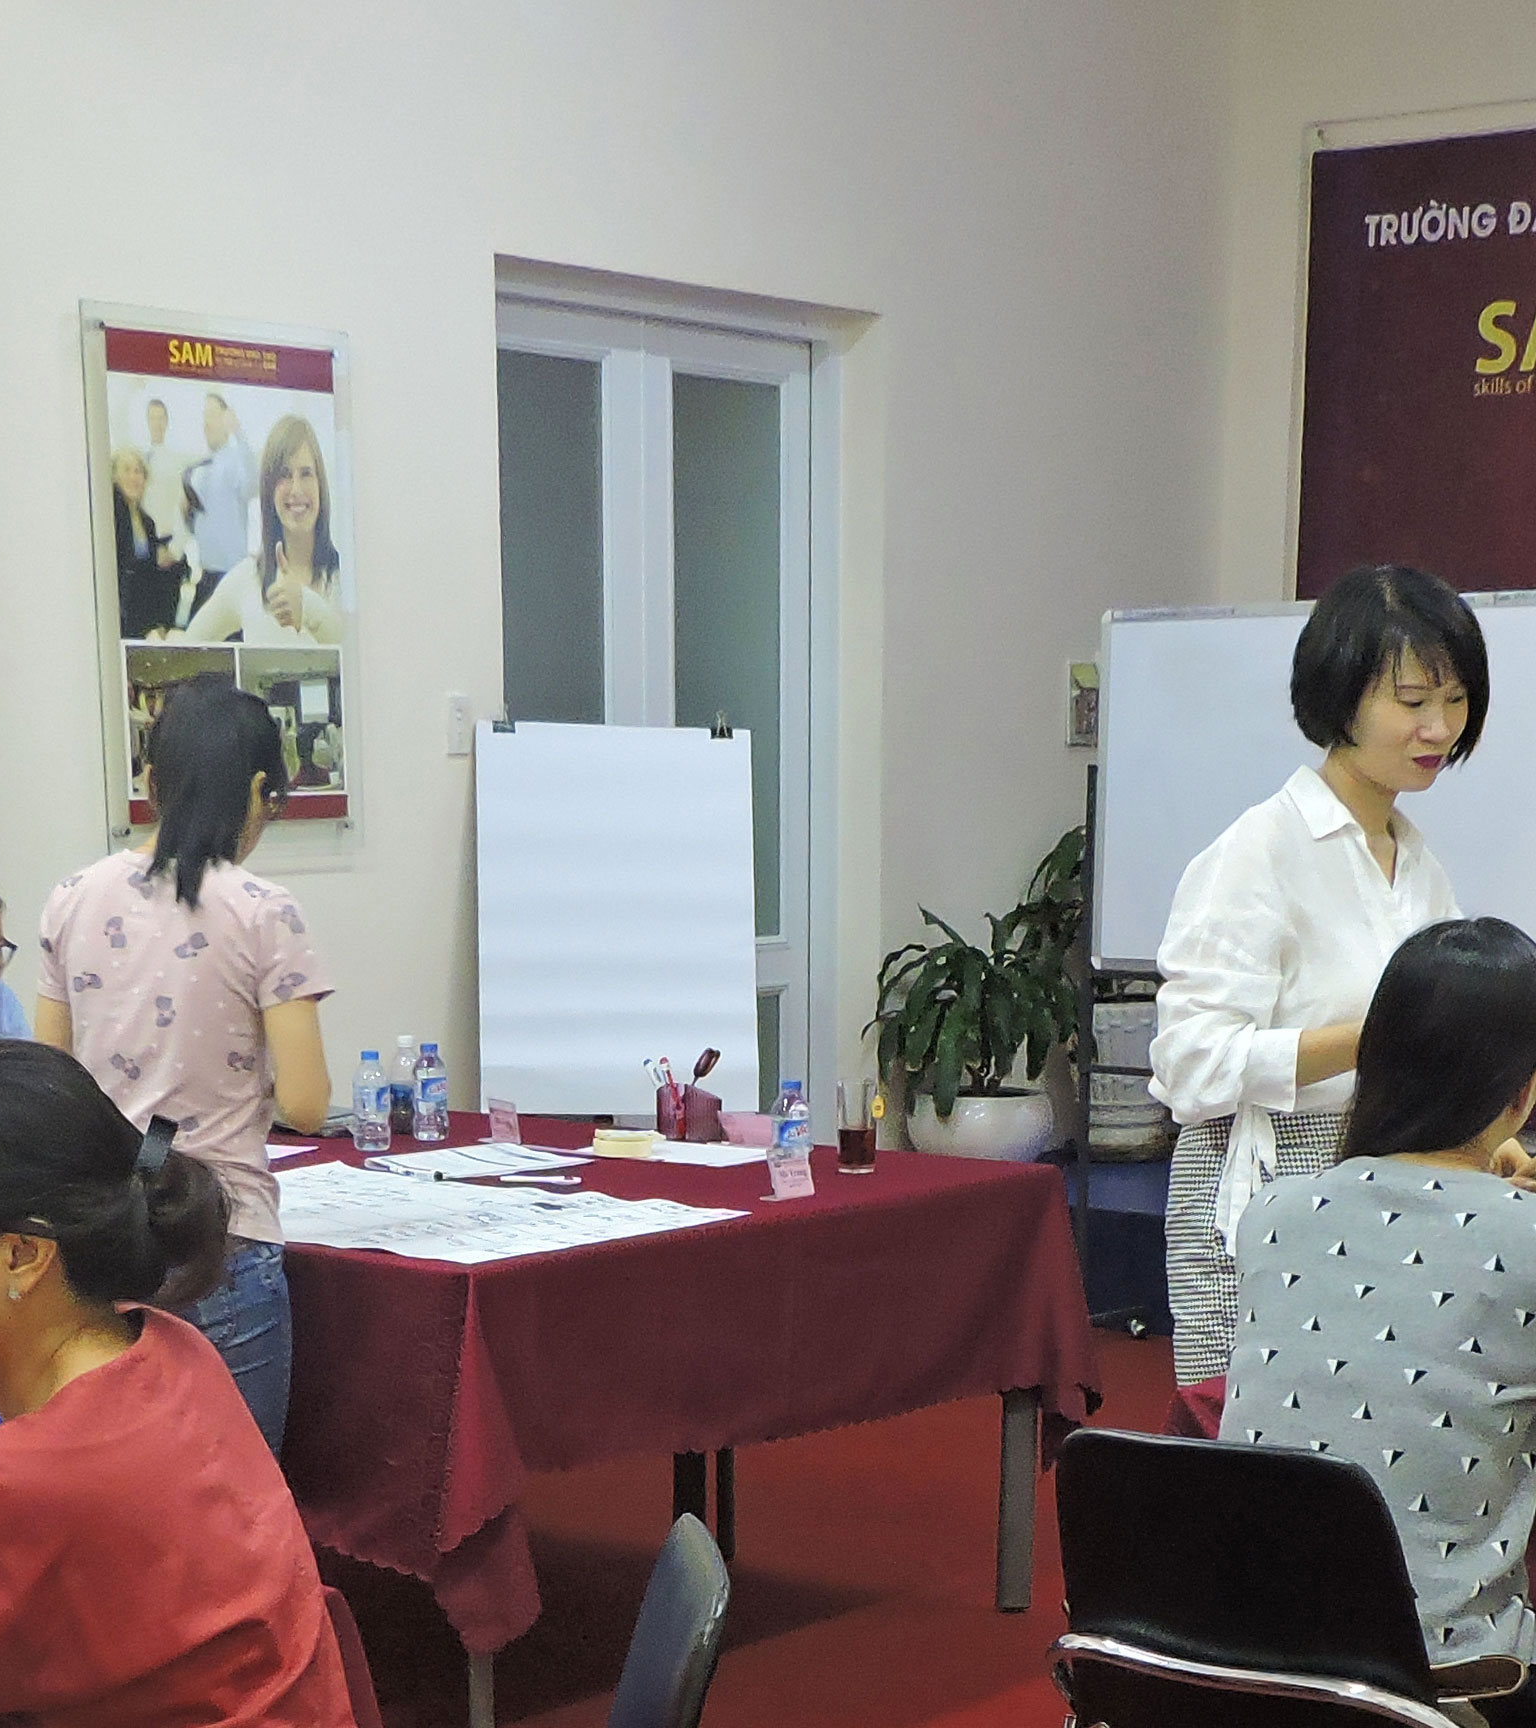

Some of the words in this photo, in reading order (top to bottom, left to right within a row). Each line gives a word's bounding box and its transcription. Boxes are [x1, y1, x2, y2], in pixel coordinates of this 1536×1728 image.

[1365, 200, 1497, 249] TRƯỜNG
[168, 338, 213, 368] SAM
[1474, 376, 1512, 396] skills
[1516, 374, 1534, 394] of
